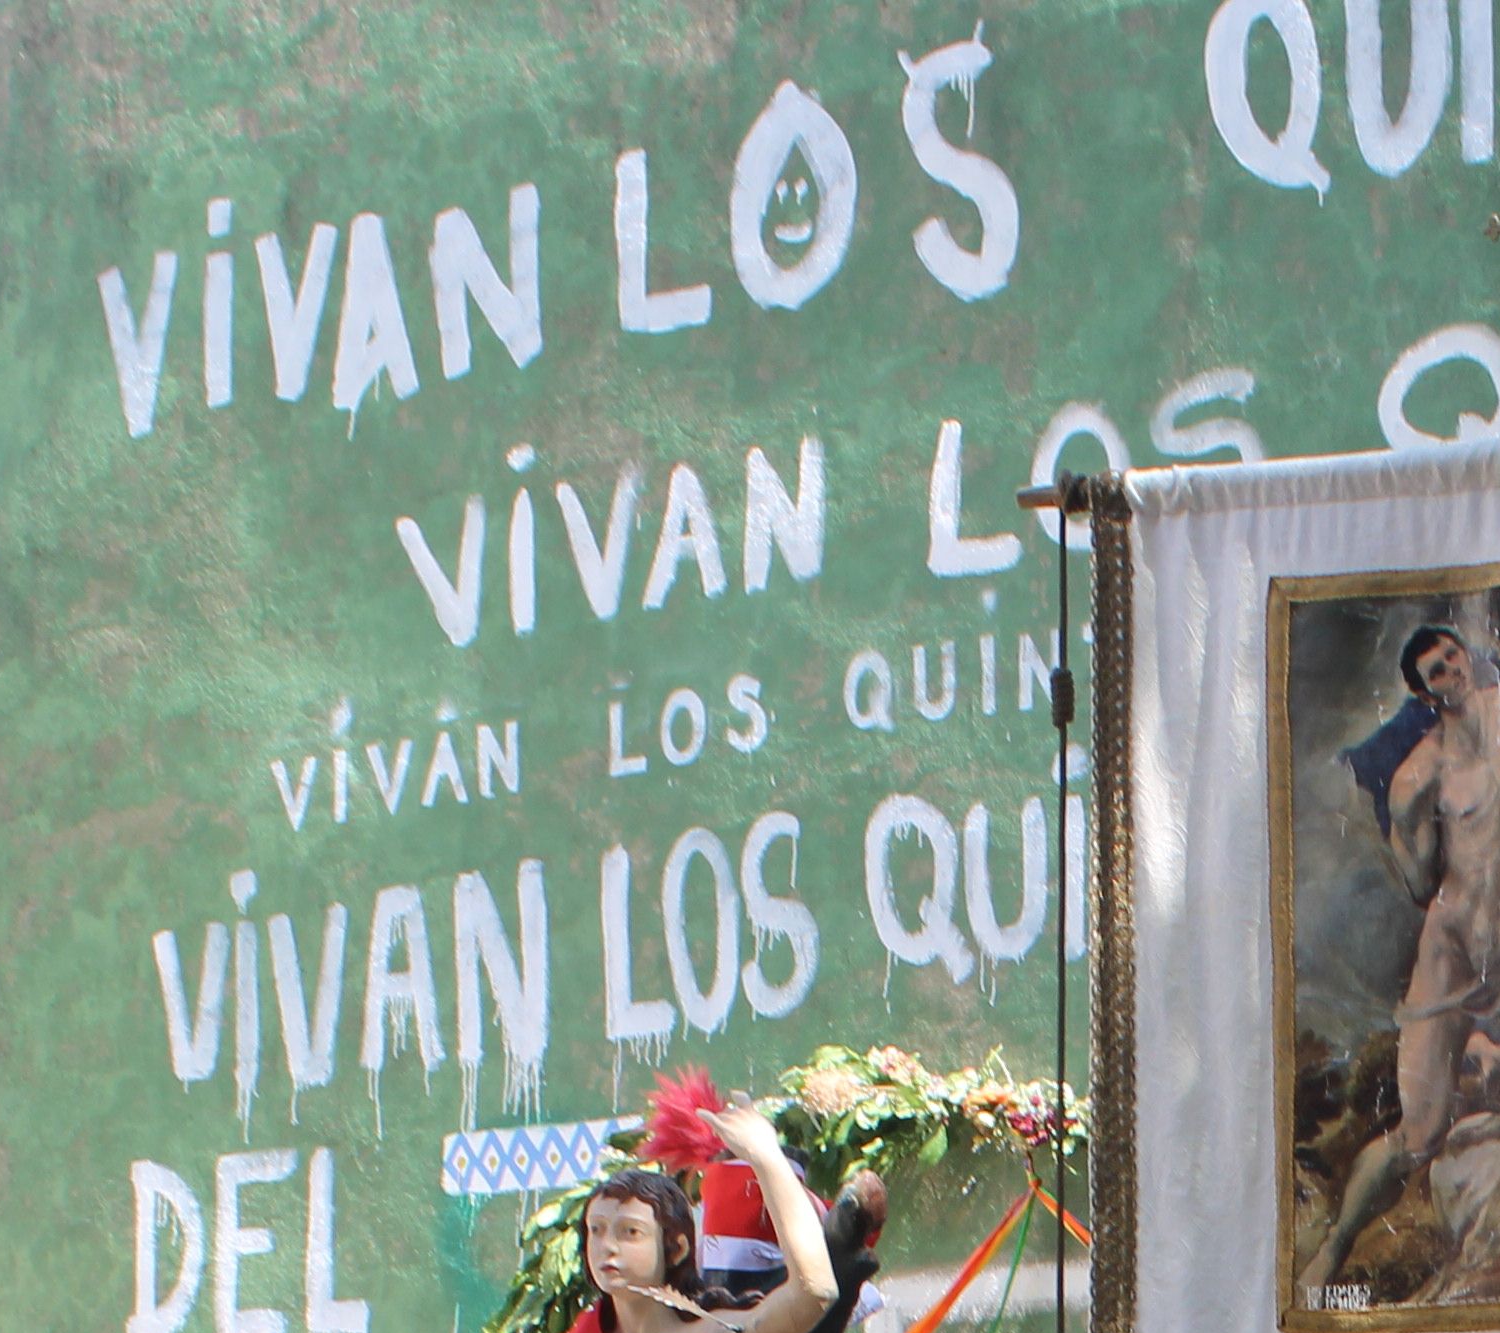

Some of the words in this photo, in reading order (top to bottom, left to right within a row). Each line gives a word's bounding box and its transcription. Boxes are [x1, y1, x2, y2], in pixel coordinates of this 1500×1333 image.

[614, 24, 1020, 332] LOS
[608, 674, 769, 778] LOS
[601, 812, 820, 1042] LOS
